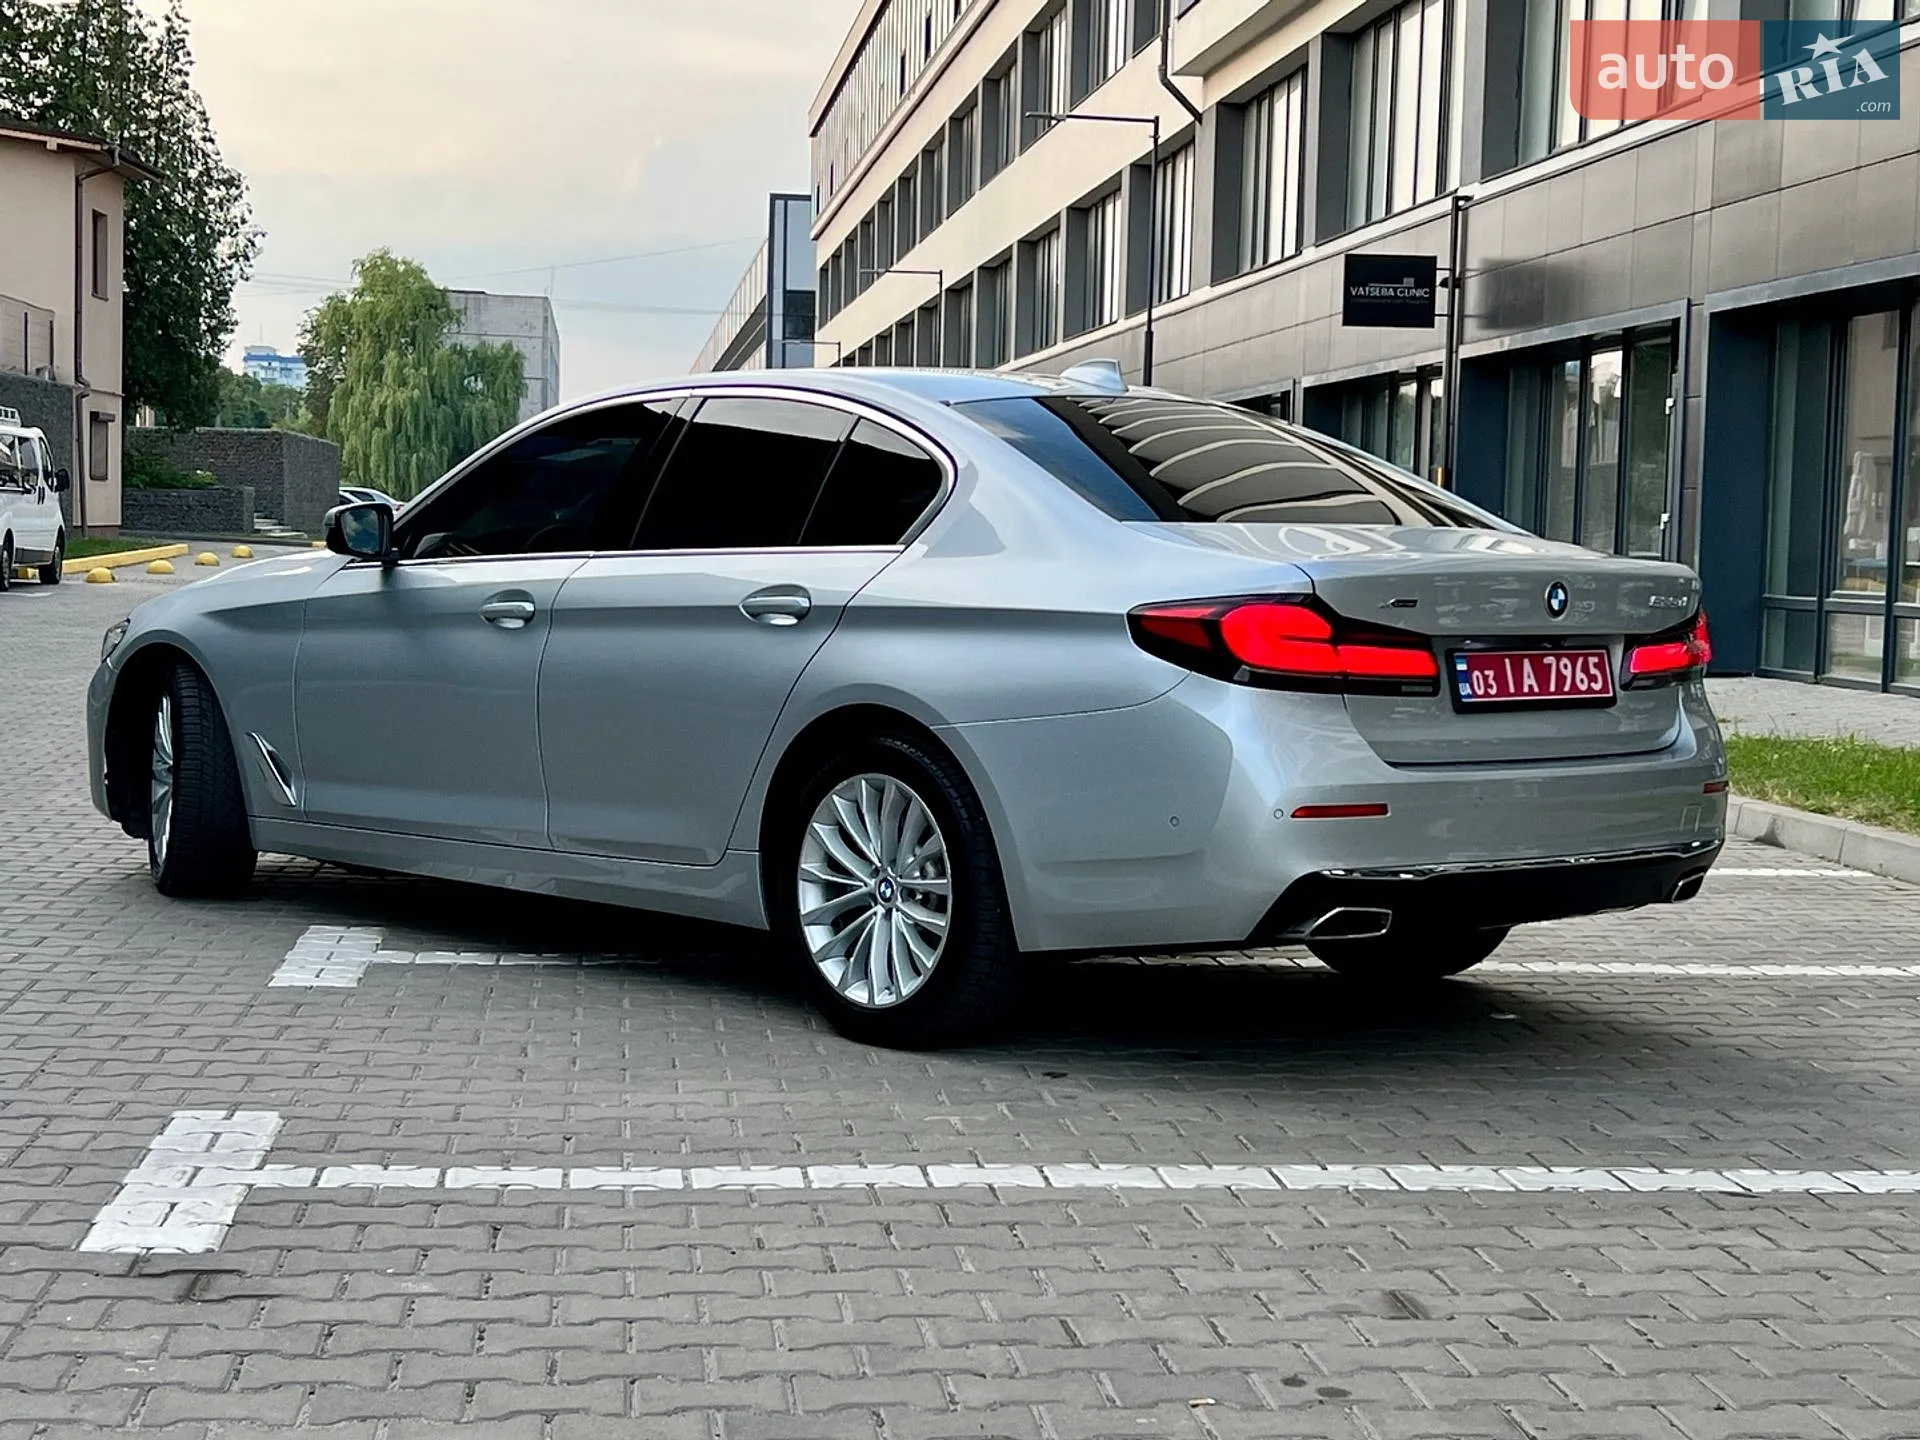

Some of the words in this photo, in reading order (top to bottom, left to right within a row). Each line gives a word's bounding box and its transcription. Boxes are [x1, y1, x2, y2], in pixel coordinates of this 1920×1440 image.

[1350, 286, 1395, 297] VATSEBA
[1396, 287, 1430, 298] CLINIC
[1472, 670, 1497, 696] 03
[1543, 656, 1604, 693] 7965
